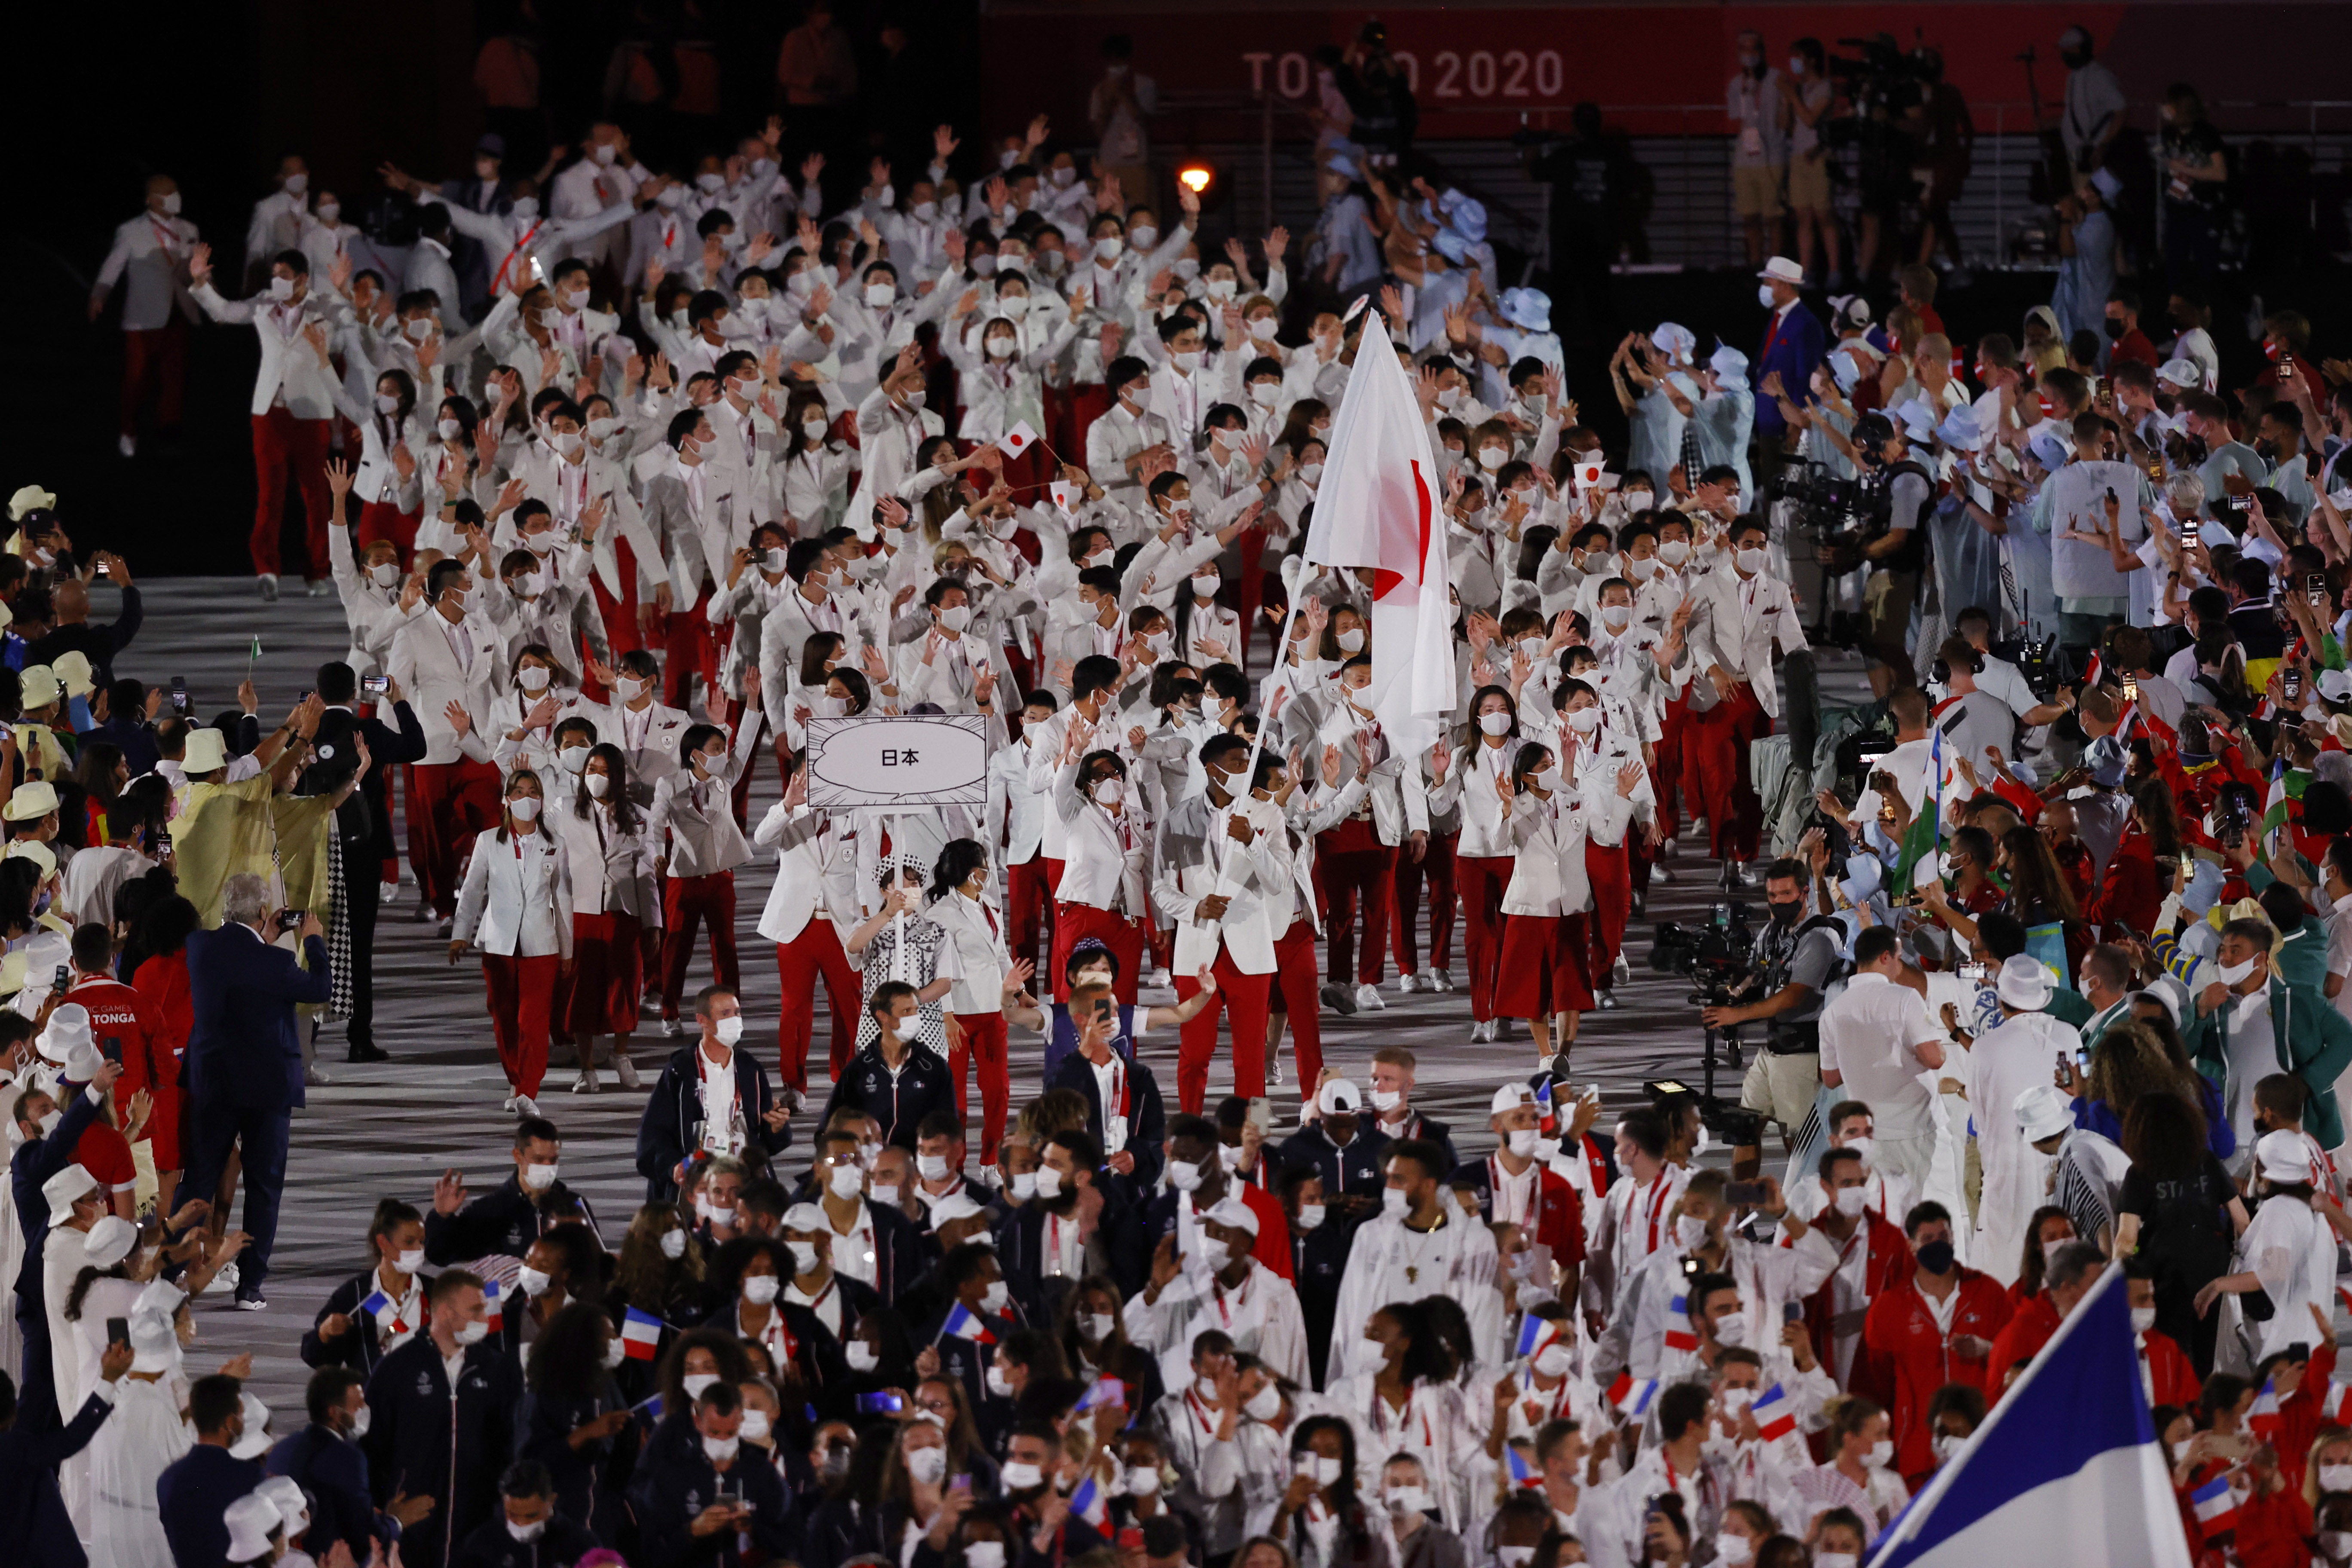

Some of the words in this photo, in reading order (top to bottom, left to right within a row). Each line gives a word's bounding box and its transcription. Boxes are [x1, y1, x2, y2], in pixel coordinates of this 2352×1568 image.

[1242, 52, 1419, 98] TOO
[1434, 50, 1564, 97] 2020
[882, 748, 919, 766] 日本
[101, 1005, 132, 1013] GAMES
[92, 1013, 136, 1024] TONGA
[2156, 1175, 2209, 1199] STF
